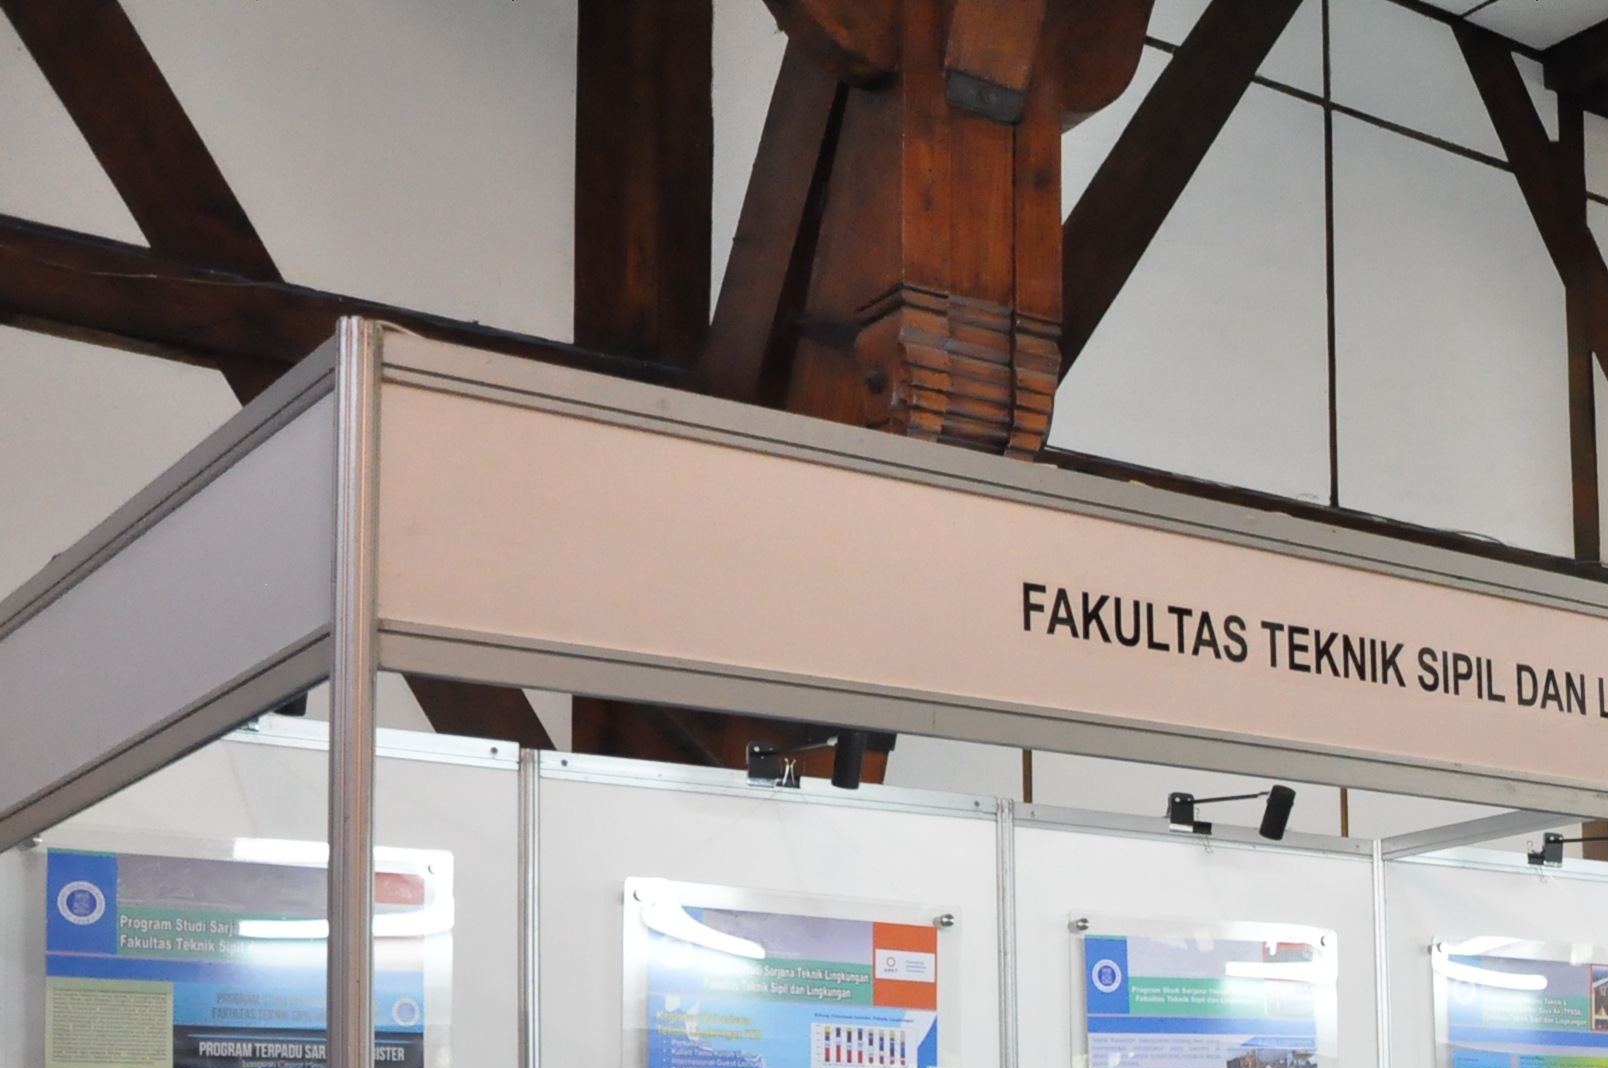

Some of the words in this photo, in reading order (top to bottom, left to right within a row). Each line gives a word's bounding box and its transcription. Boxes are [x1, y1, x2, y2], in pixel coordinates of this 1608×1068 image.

[1021, 583, 1248, 662] FAKULTAS
[1262, 621, 1407, 687] TEKNIK
[1417, 648, 1506, 703] SIPIL
[1517, 664, 1587, 717] DAN
[120, 915, 171, 932] Program
[176, 918, 206, 933] Studi
[210, 920, 240, 936] Sarja
[120, 935, 172, 950] Fakultas
[176, 938, 215, 952] Teknik
[765, 965, 795, 979] Sarjana
[797, 967, 822, 980] Teknik
[825, 969, 869, 984] Lingkungan
[771, 983, 788, 995] Sipil
[790, 984, 805, 995] dan
[807, 985, 851, 999] Lingkungan
[199, 1042, 252, 1057] PROGRAM
[254, 1043, 302, 1059] TERPADU
